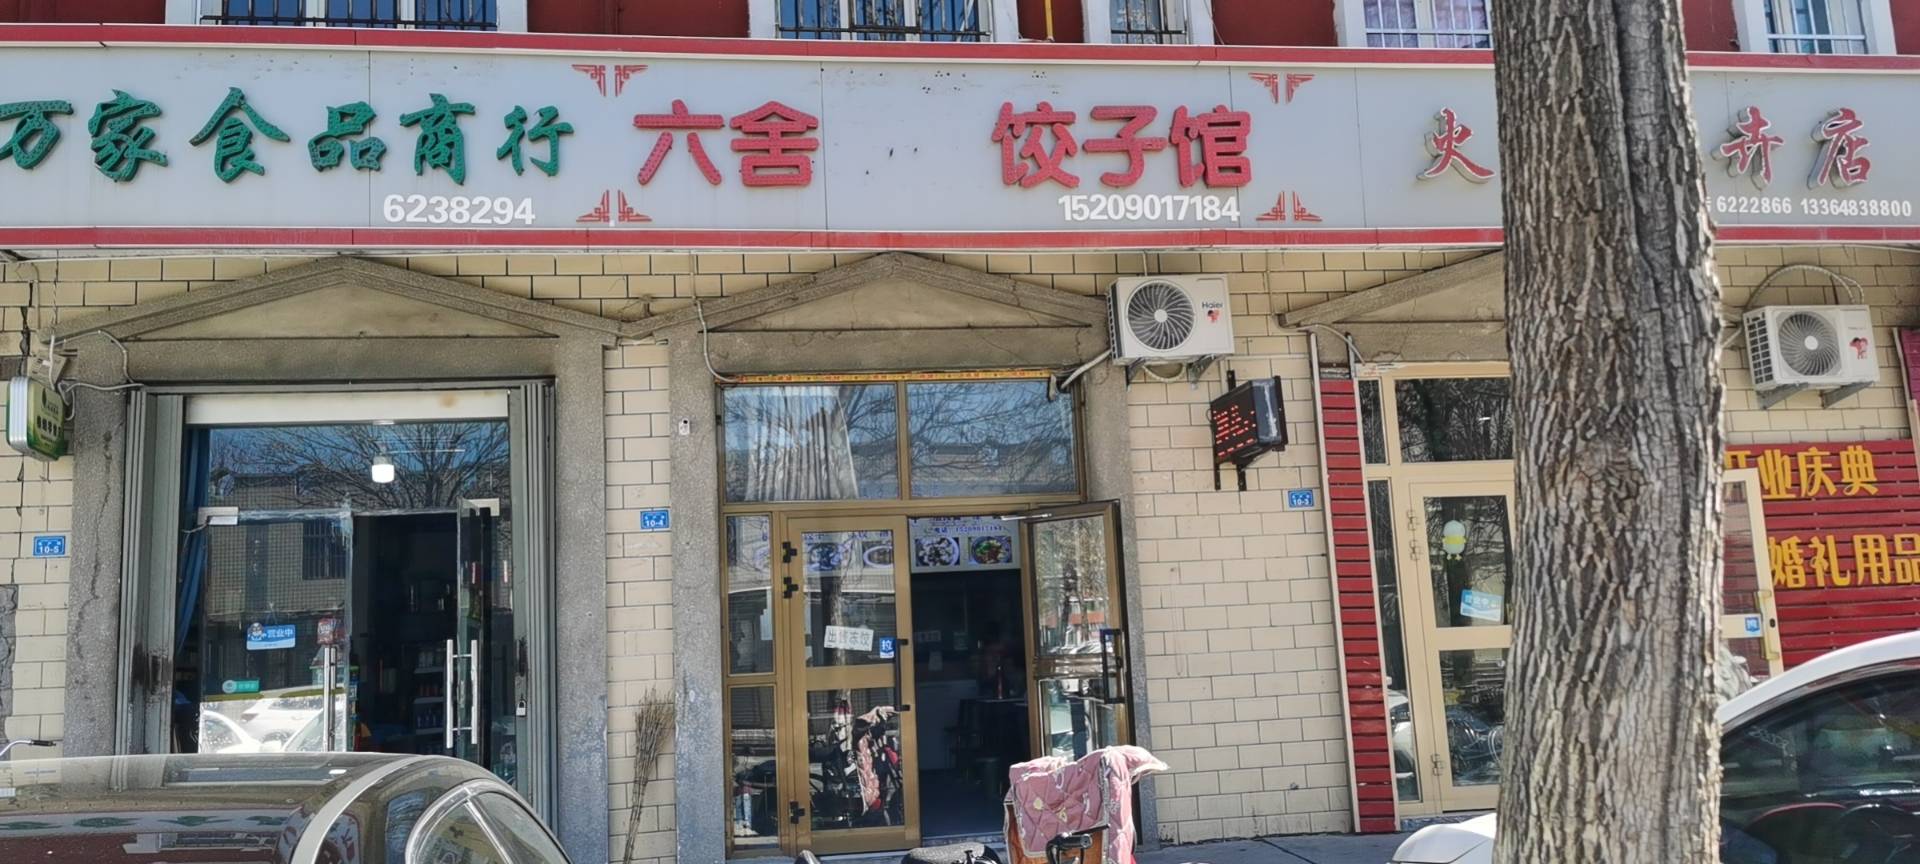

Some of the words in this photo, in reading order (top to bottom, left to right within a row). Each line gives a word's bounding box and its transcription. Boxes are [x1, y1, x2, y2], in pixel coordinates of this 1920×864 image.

[0, 86, 574, 186] 万家食品商行
[634, 99, 819, 187] 六舍
[991, 101, 1252, 188] 饺子馆
[383, 194, 535, 225] 6238294
[1058, 194, 1240, 222] 15209017184
[1716, 196, 1792, 214] 6222866
[1800, 198, 1912, 217] 13364838800
[1201, 301, 1223, 309] Haier
[1768, 533, 1920, 588] 婚礼用品
[881, 639, 894, 651] 拉
